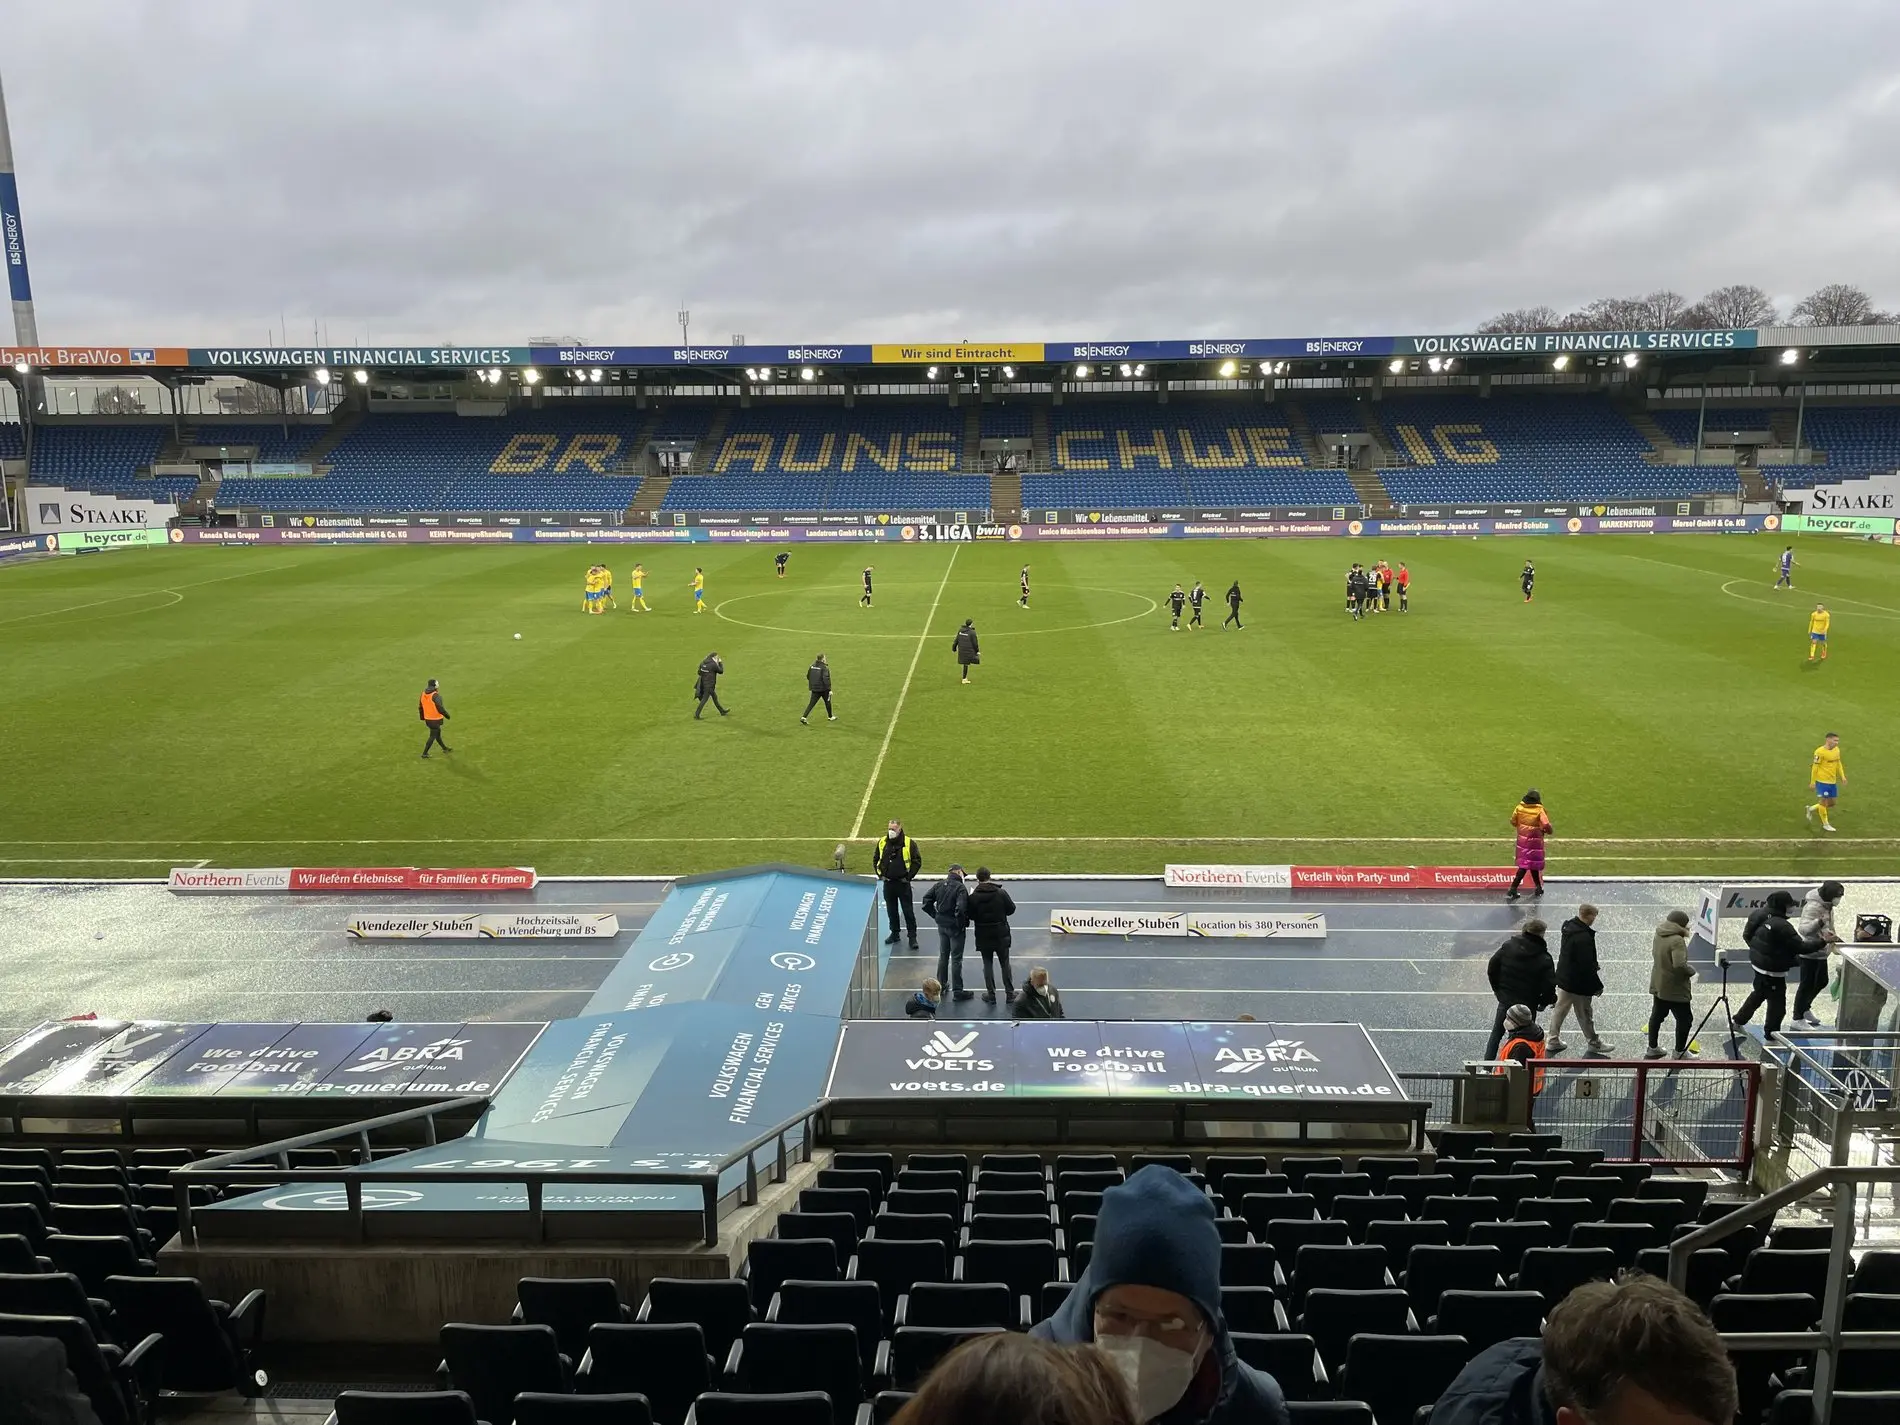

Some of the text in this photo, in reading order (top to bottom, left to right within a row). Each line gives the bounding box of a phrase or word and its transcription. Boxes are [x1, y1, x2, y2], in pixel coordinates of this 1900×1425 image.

[1413, 331, 1734, 353] VOLKSWAGEN FINANCIAL SERVICES
[57, 349, 122, 365] BraWo
[207, 349, 511, 366] VOLKSWAGEN FINANCIAL SERVICES
[901, 346, 1016, 359] Wir sind Eintracht.
[1812, 489, 1894, 509] STAAKE
[70, 503, 148, 524] STAAKE
[1579, 505, 1656, 516] Wir Lebensmittel.
[290, 517, 302, 526] Wir
[316, 517, 364, 527] Lebensmittel.
[864, 514, 938, 525] Wir Lebensmittel.
[1075, 513, 1149, 523] Wir Lebensmittel.
[1495, 521, 1521, 529] Manfred
[1599, 520, 1653, 528] MARKENSTUDIO
[1697, 519, 1716, 527] GmbH
[1717, 519, 1723, 527] &
[1724, 519, 1734, 527] Co.
[1736, 518, 1746, 527] KG
[1807, 517, 1871, 531] heycar.de
[771, 529, 789, 537] GmbH
[839, 529, 857, 537] GmbH
[919, 525, 972, 540] 3. LIGA
[976, 525, 1005, 535] bwin
[1149, 526, 1168, 534] GmbH
[84, 532, 147, 546] heycar.de
[173, 871, 526, 886] Northern Events Wir liefern Erlebnisse für Familien & Firmen
[1171, 868, 1523, 886] Northern Events Verleih von Party- und Eventausstattun
[789, 891, 817, 930] VOLKSWAGEN
[805, 886, 839, 945] FINANCIAL SERVICES
[355, 918, 473, 932] Wendezeller Stuben
[516, 915, 580, 926] Hochzeitssäle
[1060, 915, 1180, 930] Wendezeller Stuben
[1195, 919, 1319, 930] Location bis 380 Personen
[496, 924, 596, 937] in Wendeburg und BS
[777, 983, 802, 1013] RVICES
[203, 1046, 319, 1058] We drive
[359, 1047, 463, 1061] ABRA
[1047, 1046, 1166, 1058] We drive
[1214, 1047, 1322, 1062] ABRA
[187, 1061, 303, 1073] Football
[571, 1032, 629, 1100] VOLKSWAGEN
[708, 1031, 754, 1100] VOLKSWAGEN
[905, 1058, 994, 1072] VOETS
[1052, 1061, 1167, 1073] Football
[531, 1022, 612, 1123] FINANCIAL SERVICES
[728, 1021, 784, 1124] FINANCIAL SERVICES
[272, 1079, 490, 1094] abra-querum.de
[890, 1078, 1006, 1092] voets.de
[1167, 1081, 1391, 1096] abra-querum.de
[1583, 1081, 1592, 1099] 3
